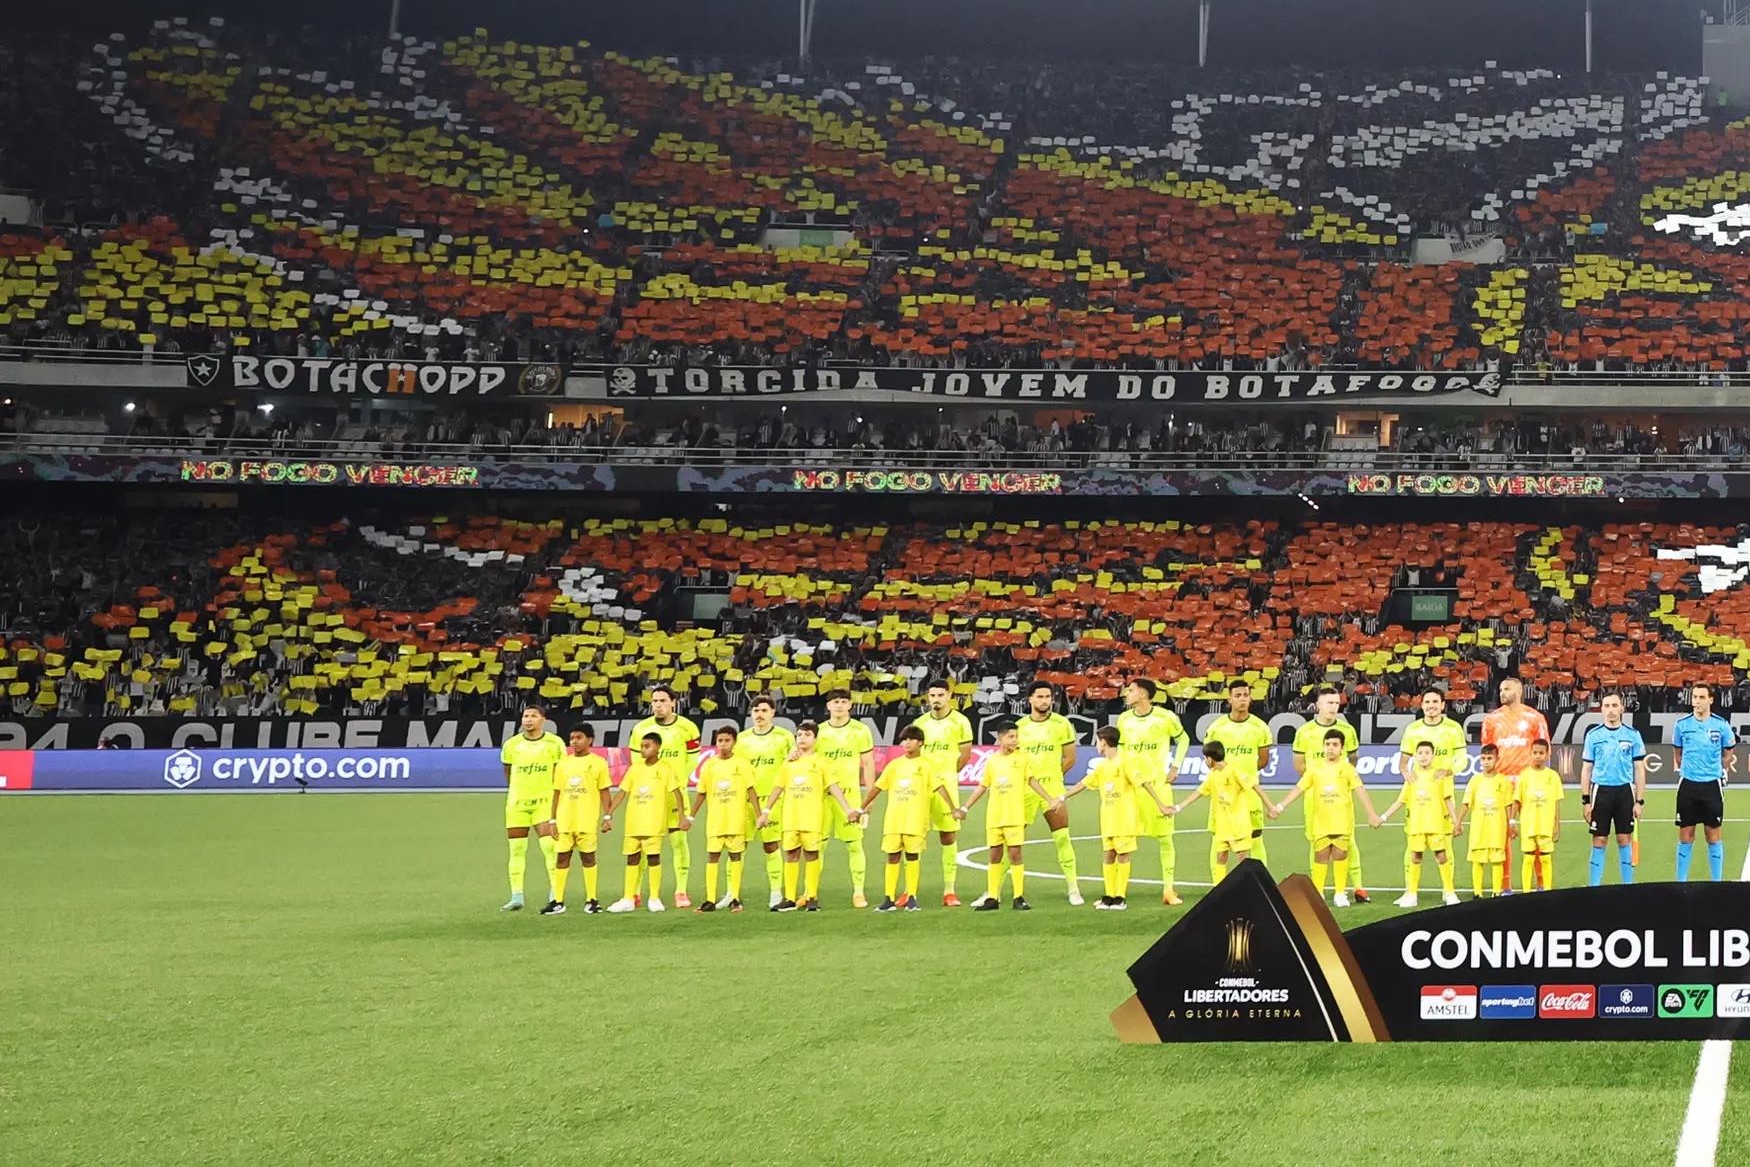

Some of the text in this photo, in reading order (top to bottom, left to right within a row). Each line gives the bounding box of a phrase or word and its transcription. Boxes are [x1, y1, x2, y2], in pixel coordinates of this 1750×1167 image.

[231, 355, 505, 395] BOTACHOPP
[648, 367, 879, 393] TORCIDA
[912, 372, 1089, 398] JOVEM
[1116, 374, 1176, 399] DO
[180, 461, 233, 480] NO
[793, 470, 840, 490] NO
[1348, 474, 1391, 492] NO
[823, 749, 853, 760] refisa
[1025, 743, 1054, 754] refisa
[1225, 745, 1253, 756] refisa
[212, 752, 410, 784] crypto.com
[1401, 929, 1668, 970] CONMEBOL
[1219, 977, 1256, 988] CONMEBOL
[1184, 988, 1289, 1003] LIBERTADORES
[1481, 996, 1535, 1008] sportingbet
[1541, 992, 1592, 1011] Coca-Cola
[1168, 1007, 1302, 1019] A GLÓRIA ETERNA
[1427, 1005, 1469, 1015] AMSTEL
[1604, 1005, 1649, 1015] crypto.com
